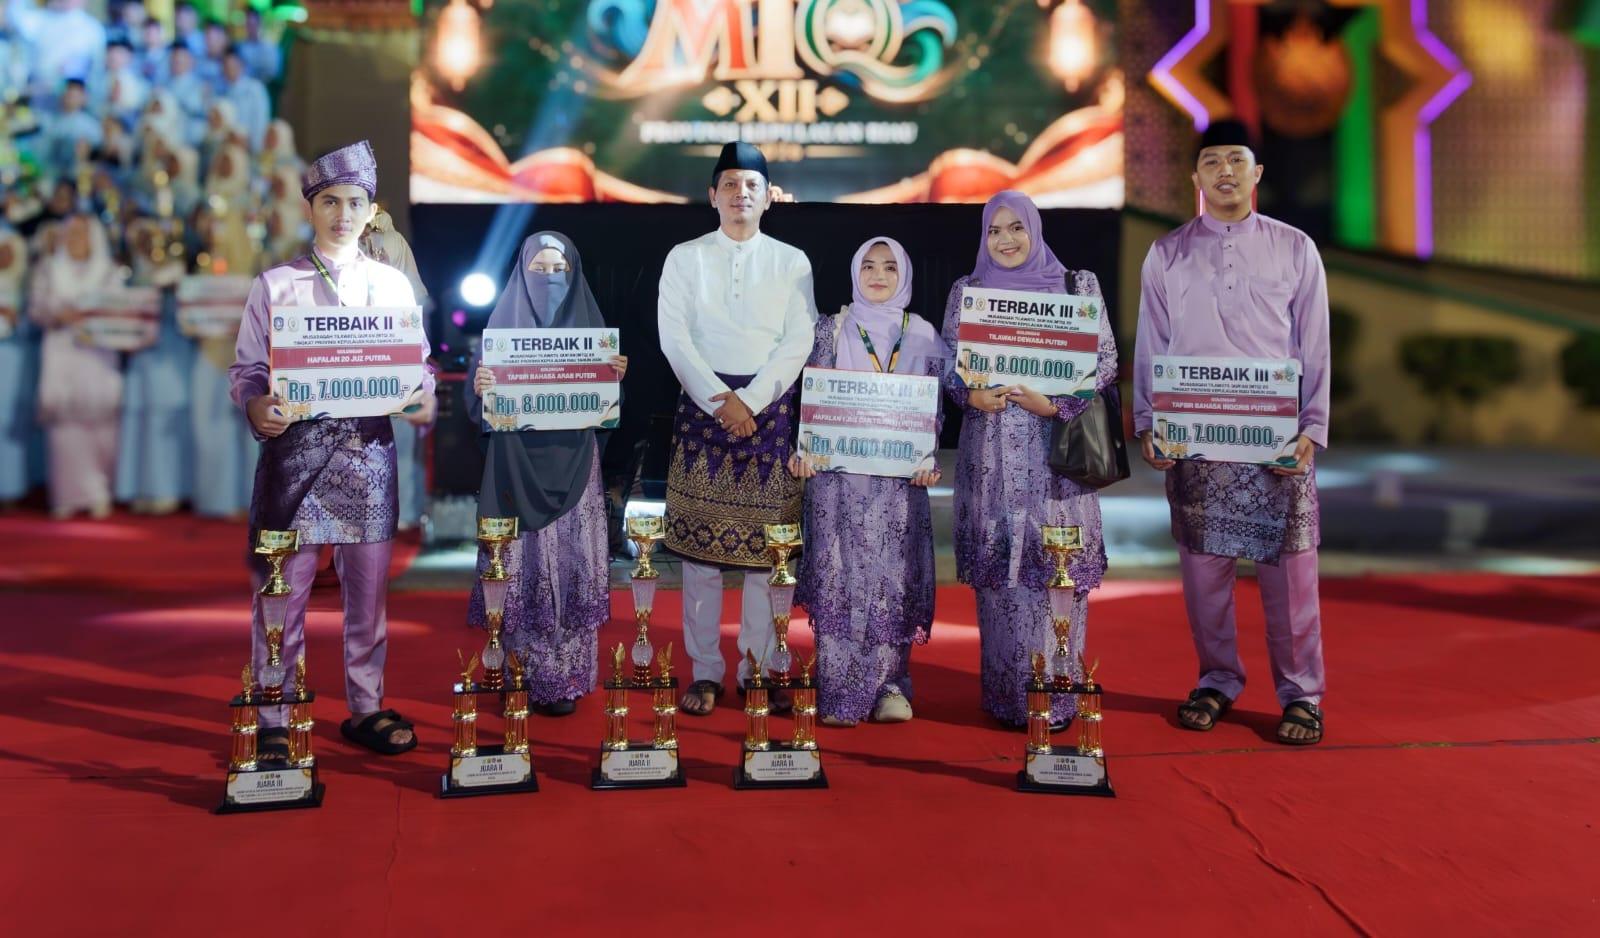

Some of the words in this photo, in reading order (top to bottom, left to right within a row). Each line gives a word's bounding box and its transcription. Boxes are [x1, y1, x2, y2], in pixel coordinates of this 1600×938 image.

[733, 78, 818, 123] XII
[988, 298, 1055, 317] TERBAIK
[1060, 304, 1073, 318] III
[304, 316, 379, 332] TERBAIK
[384, 316, 393, 330] II
[511, 338, 579, 351] TERBAIK
[584, 337, 593, 350] II
[988, 333, 1016, 342] TILAWAH
[1017, 336, 1044, 344] DEWASA
[307, 356, 340, 364] HAFALAN
[969, 352, 993, 374] Rp.
[996, 354, 1083, 382] 8.000.000,-
[1179, 366, 1250, 381] TERBAIK
[1254, 368, 1269, 382] III
[288, 380, 315, 402] Rp.
[317, 376, 410, 400] 7.000.000,-
[828, 380, 895, 397] TERBAIK
[899, 384, 913, 398] III
[495, 394, 520, 416] Rp.
[522, 392, 609, 414] 8.000.000,-
[1166, 422, 1192, 443] Rp.
[1193, 422, 1284, 449] 7.000.000,-
[810, 434, 834, 455] Rp.
[836, 436, 922, 463] 4.000.000,-
[257, 780, 275, 788] JUARA
